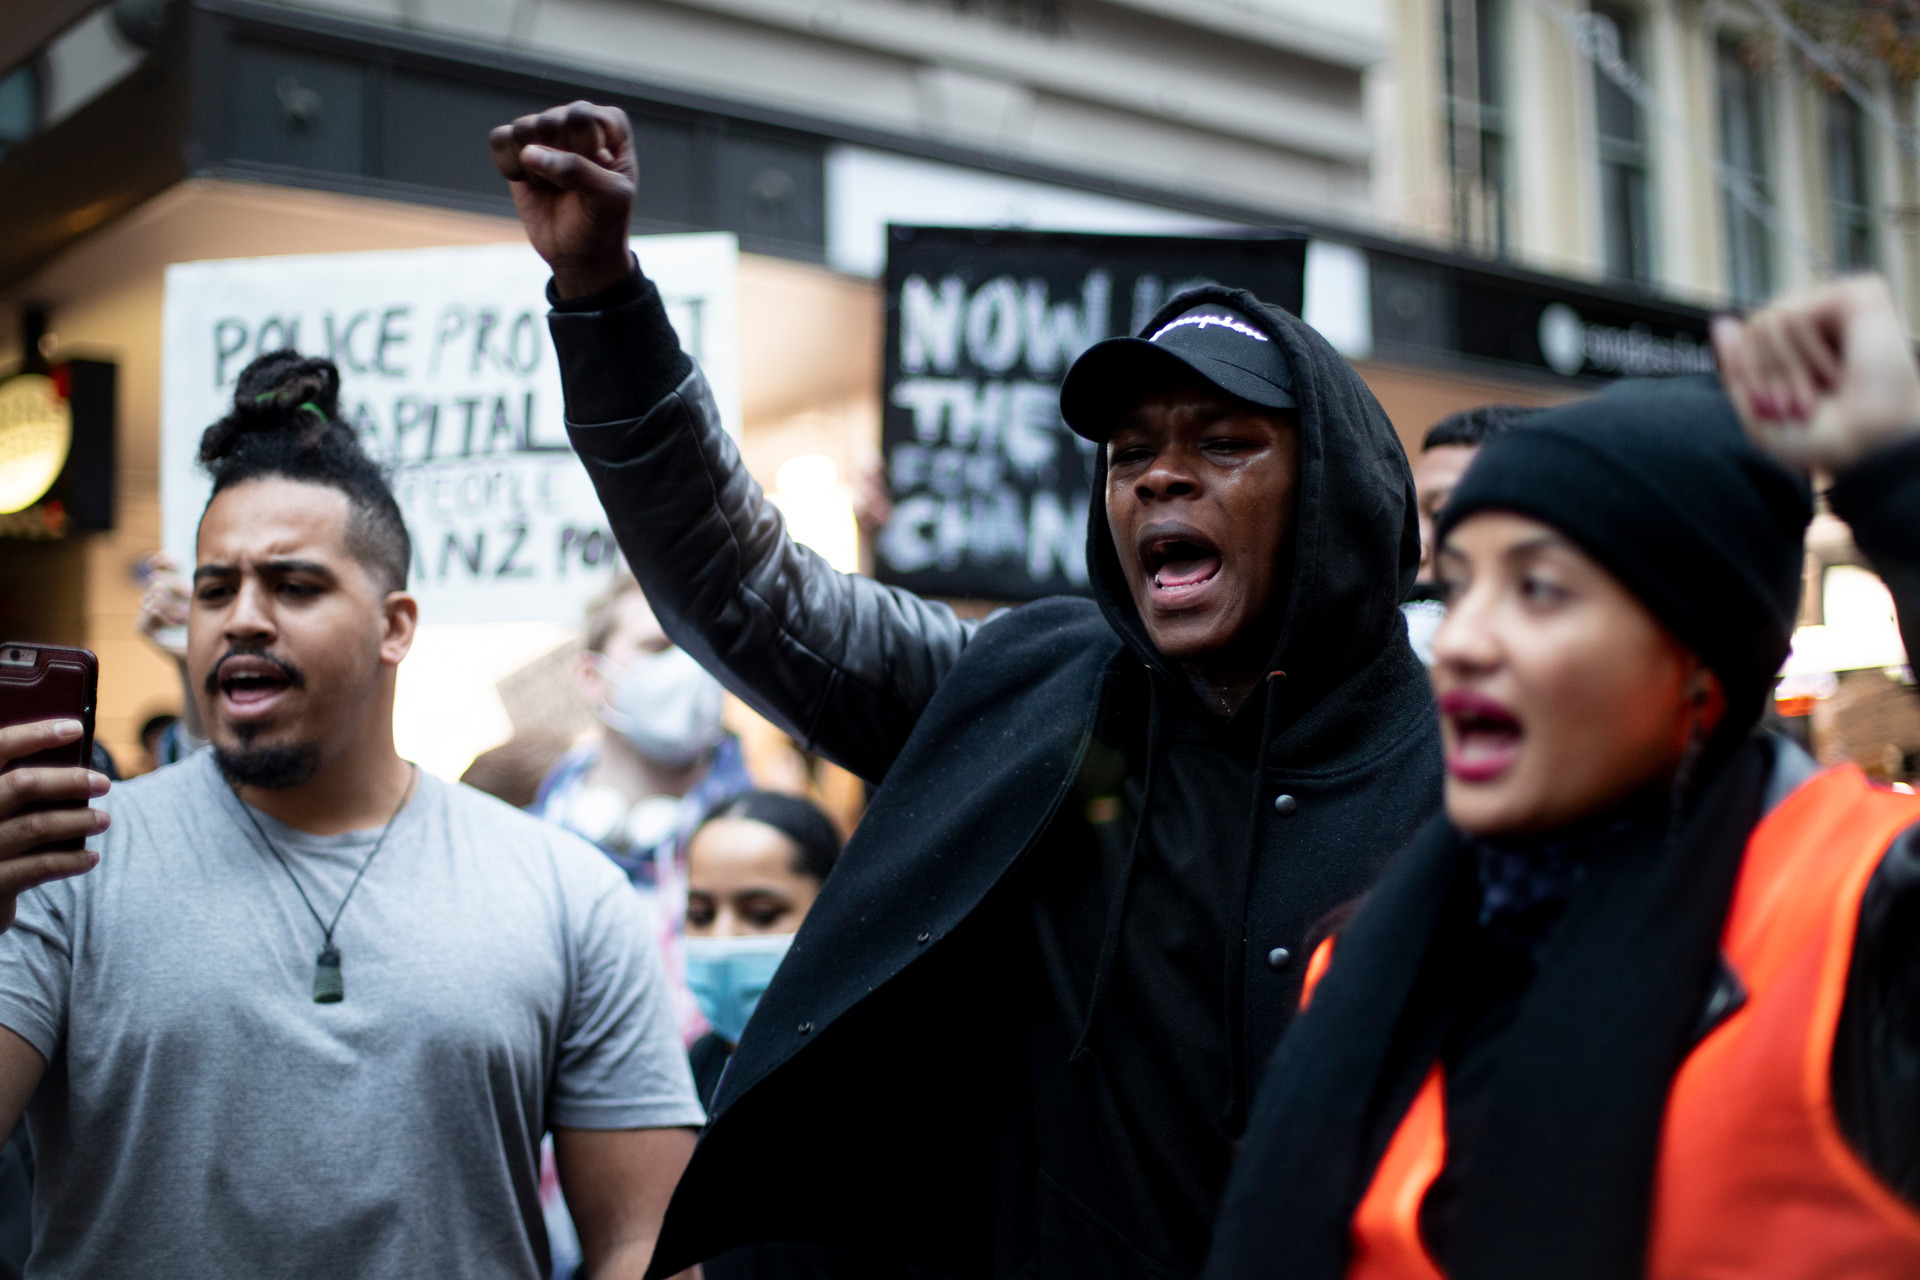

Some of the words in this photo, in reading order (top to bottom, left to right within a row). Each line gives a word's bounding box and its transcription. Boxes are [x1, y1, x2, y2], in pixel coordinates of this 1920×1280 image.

[212, 306, 412, 390] POLICE
[434, 294, 709, 376] PROT
[900, 272, 1113, 376] NOW
[350, 391, 577, 461] APITAL
[891, 380, 1059, 474] THE
[884, 487, 1091, 584] CHAN
